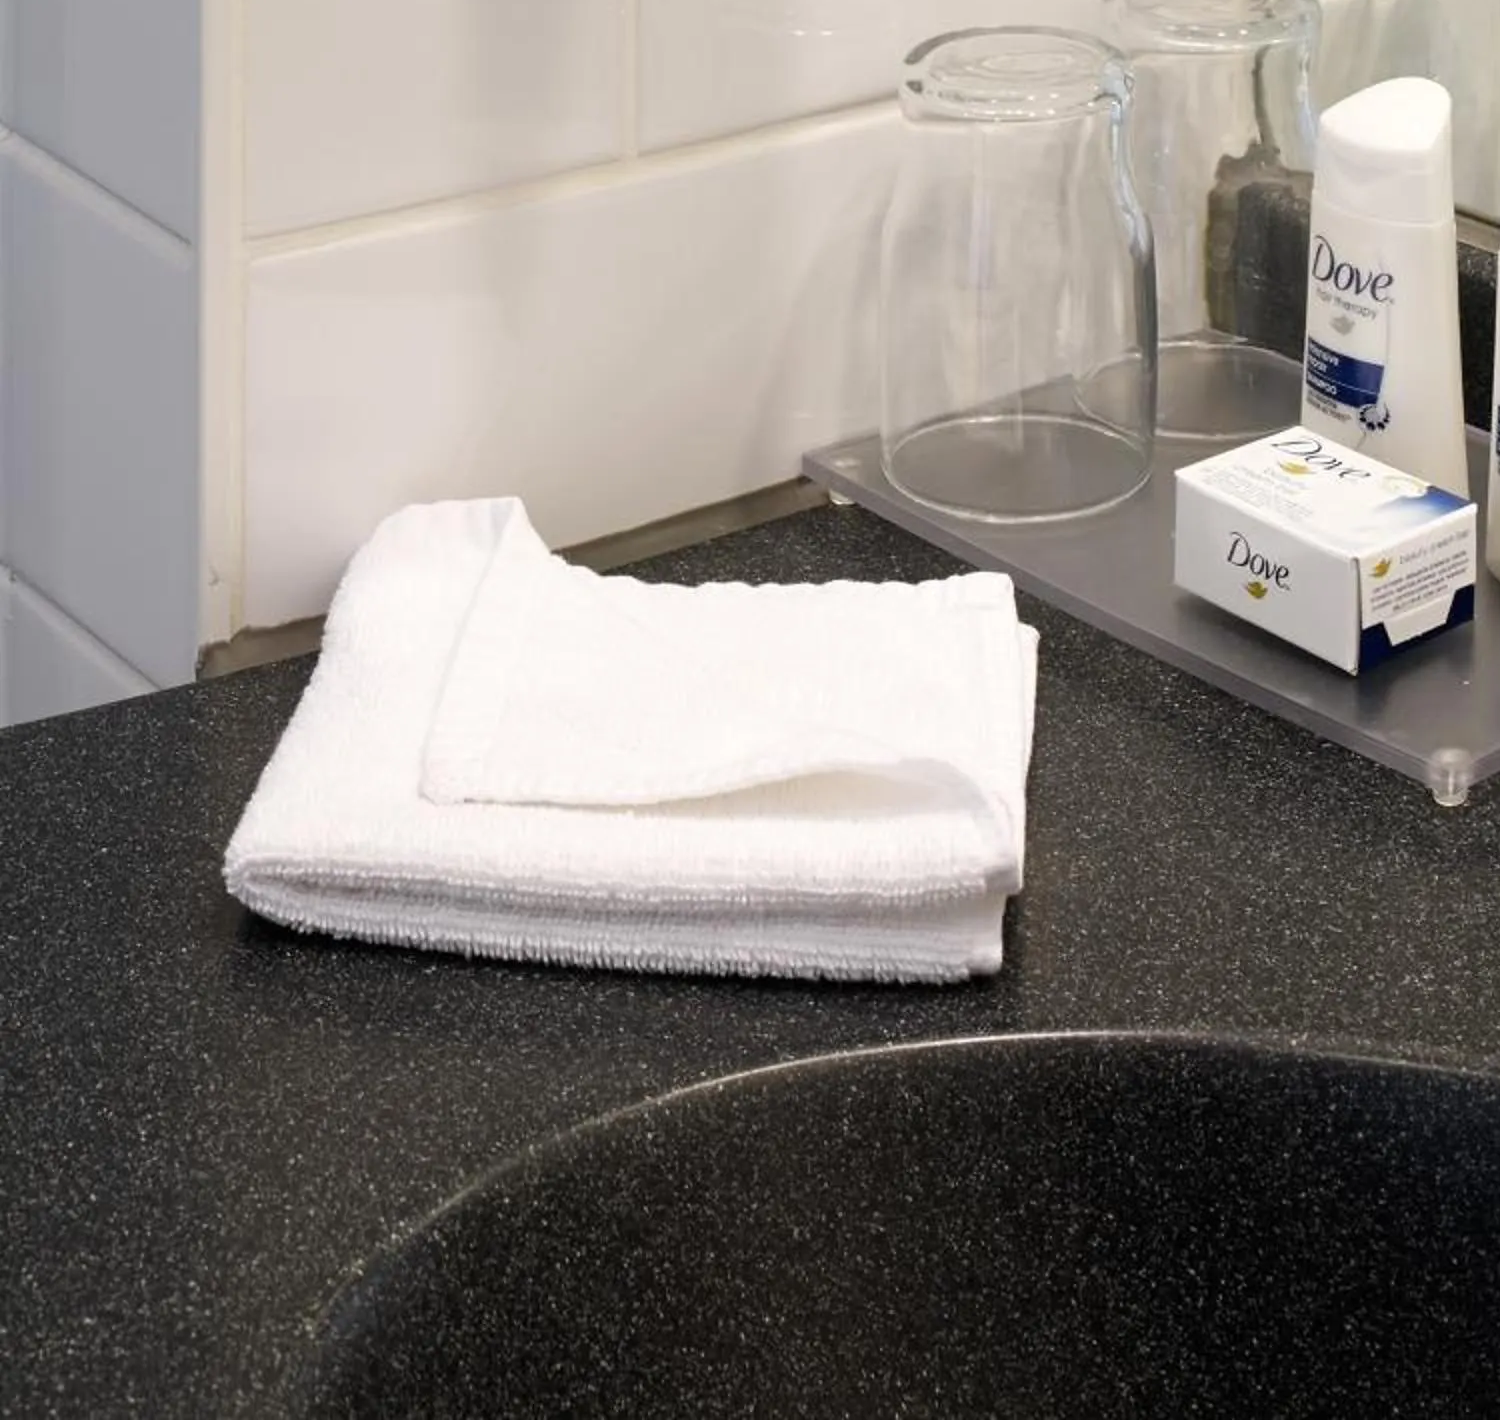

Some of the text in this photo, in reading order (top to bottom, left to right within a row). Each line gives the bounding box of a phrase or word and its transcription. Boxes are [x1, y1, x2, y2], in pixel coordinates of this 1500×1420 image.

[1311, 234, 1395, 303] Dove
[1271, 438, 1372, 479] Dove
[1226, 530, 1291, 590] Dove
